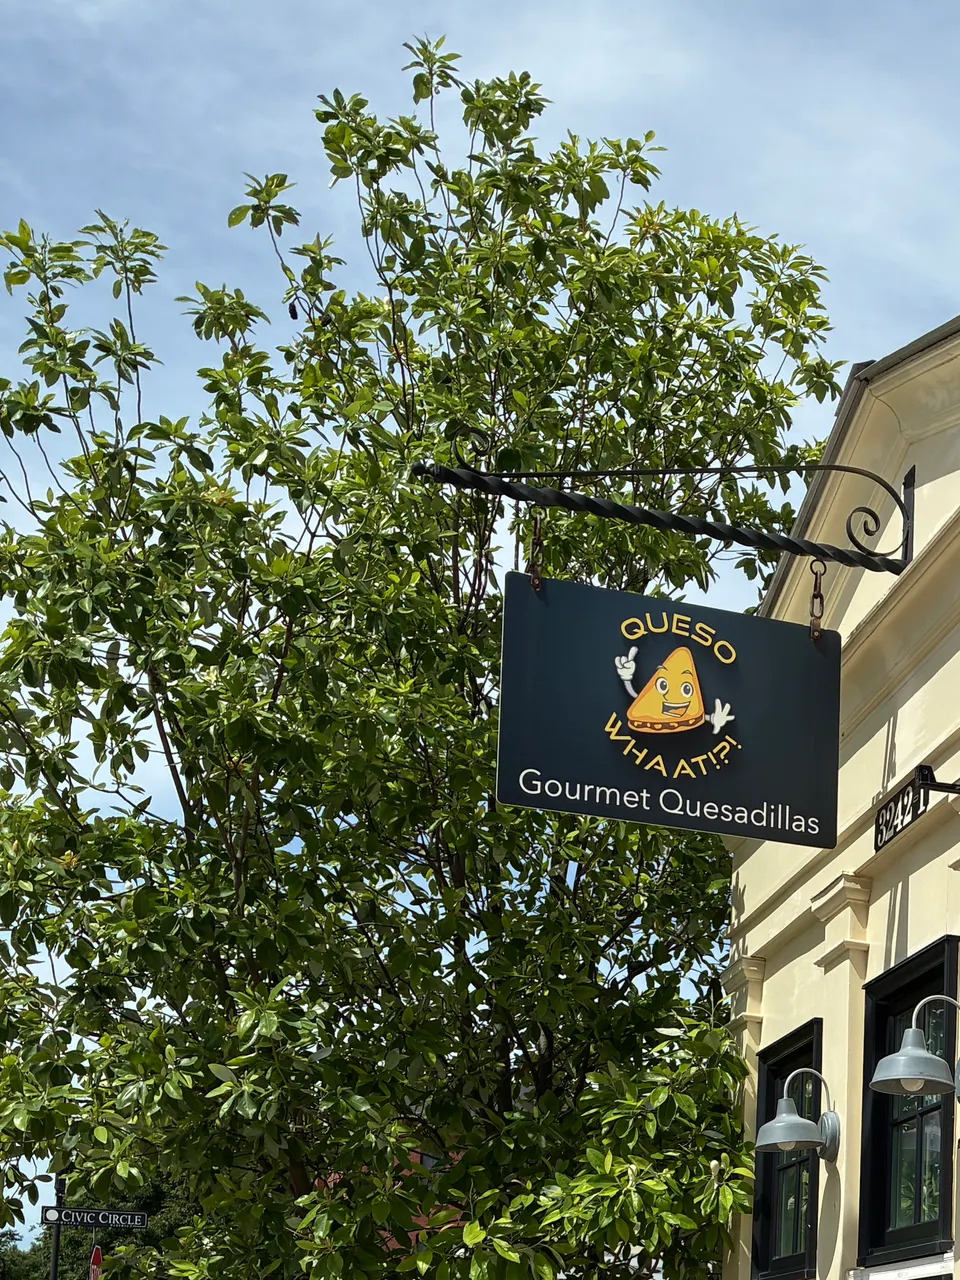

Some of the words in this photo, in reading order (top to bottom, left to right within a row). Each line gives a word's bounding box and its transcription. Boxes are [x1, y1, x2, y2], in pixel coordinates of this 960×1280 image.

[620, 612, 737, 664] QUESO
[518, 768, 651, 810] Gourmet
[659, 788, 820, 834] Quesadillas
[61, 1210, 96, 1223] CIVIC
[98, 1212, 142, 1226] CIRCLE
